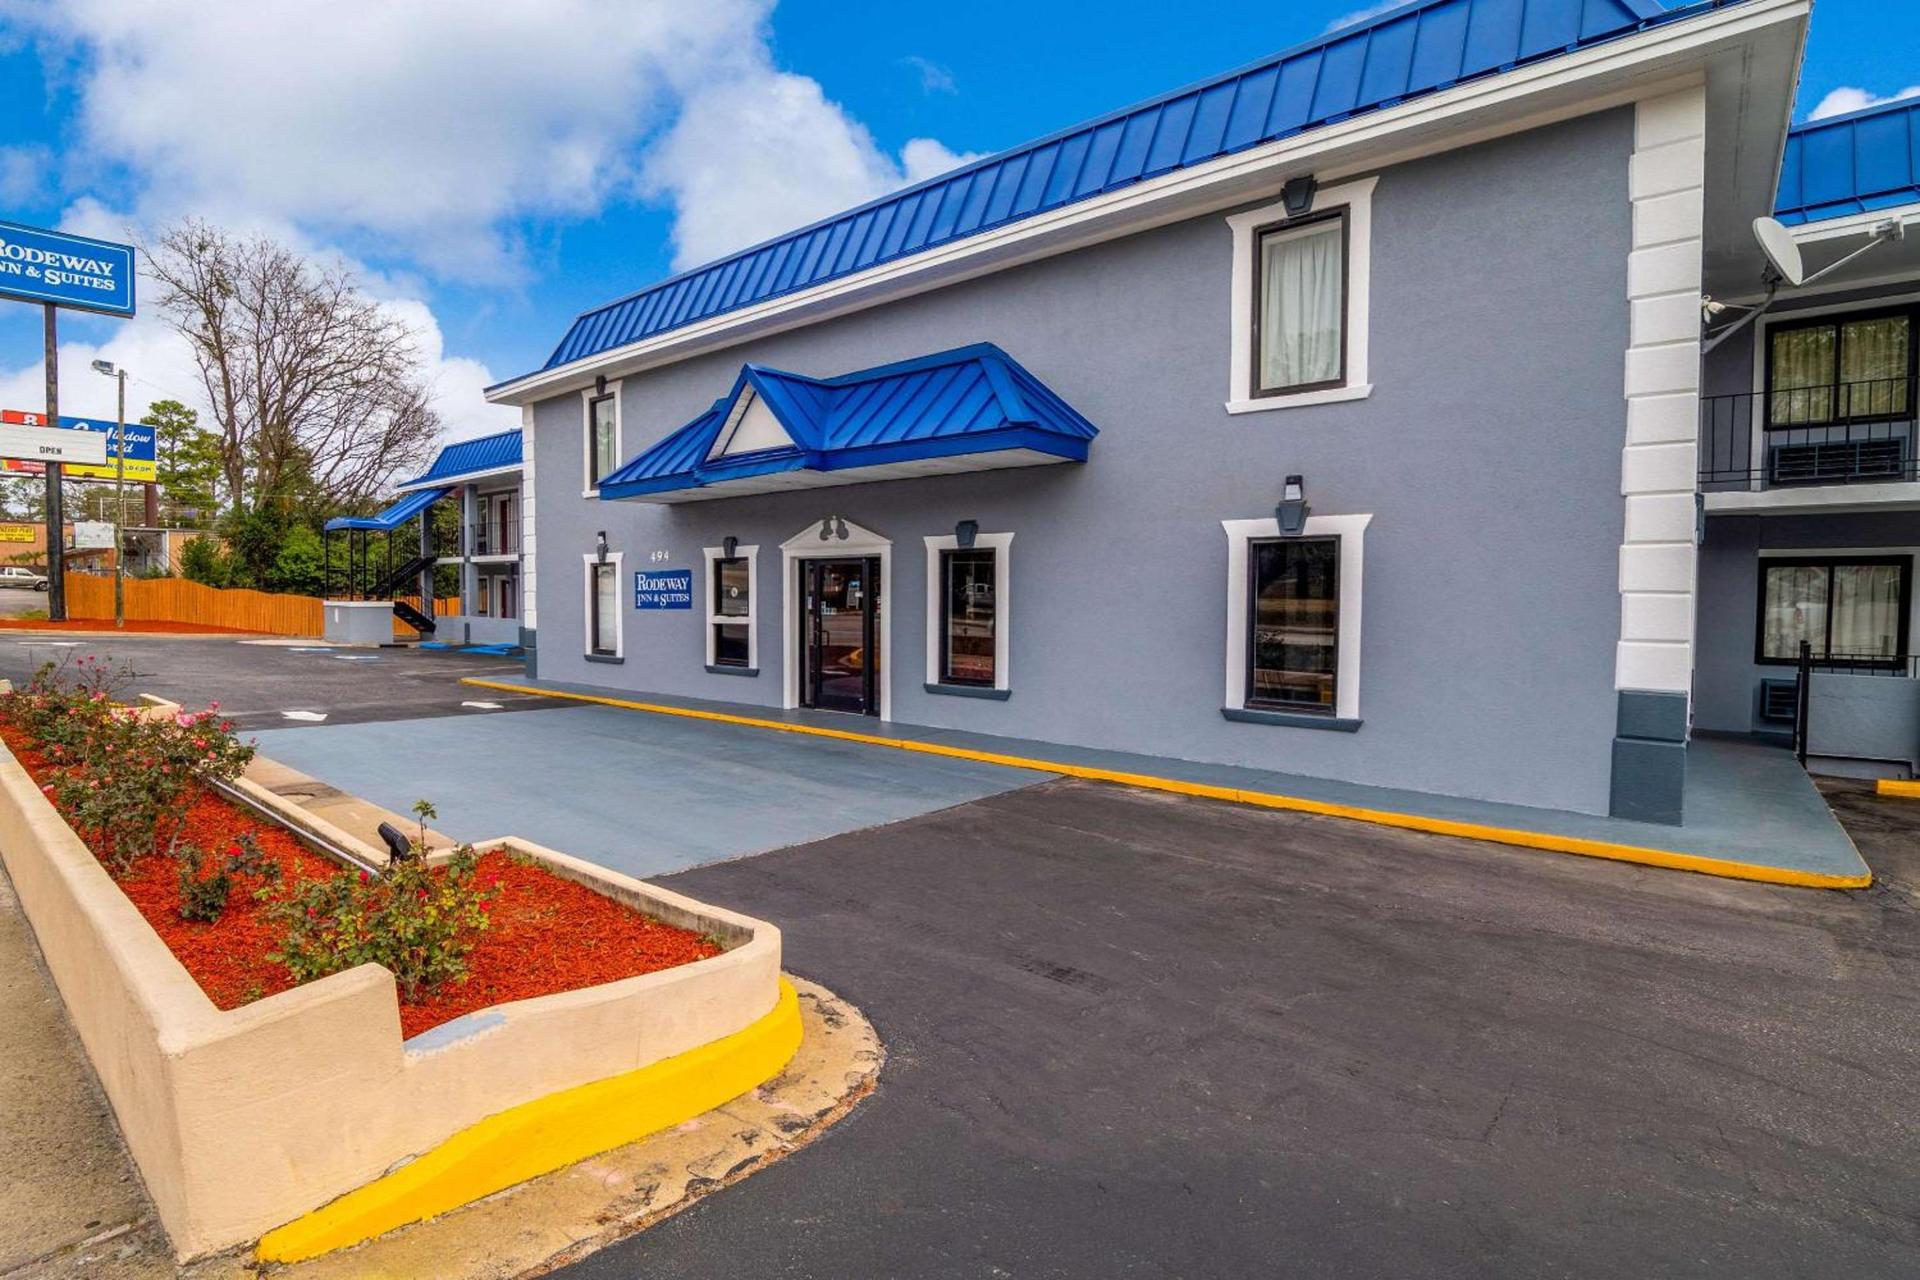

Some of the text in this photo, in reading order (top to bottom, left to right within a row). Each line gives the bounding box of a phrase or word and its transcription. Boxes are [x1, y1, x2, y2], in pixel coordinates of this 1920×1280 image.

[25, 266, 42, 278] &
[45, 269, 115, 291] SUITES
[39, 446, 62, 455] OPEN
[651, 551, 669, 562] 494
[637, 574, 689, 590] RODEWAY
[637, 594, 652, 606] INN
[660, 593, 690, 606] SUITES
